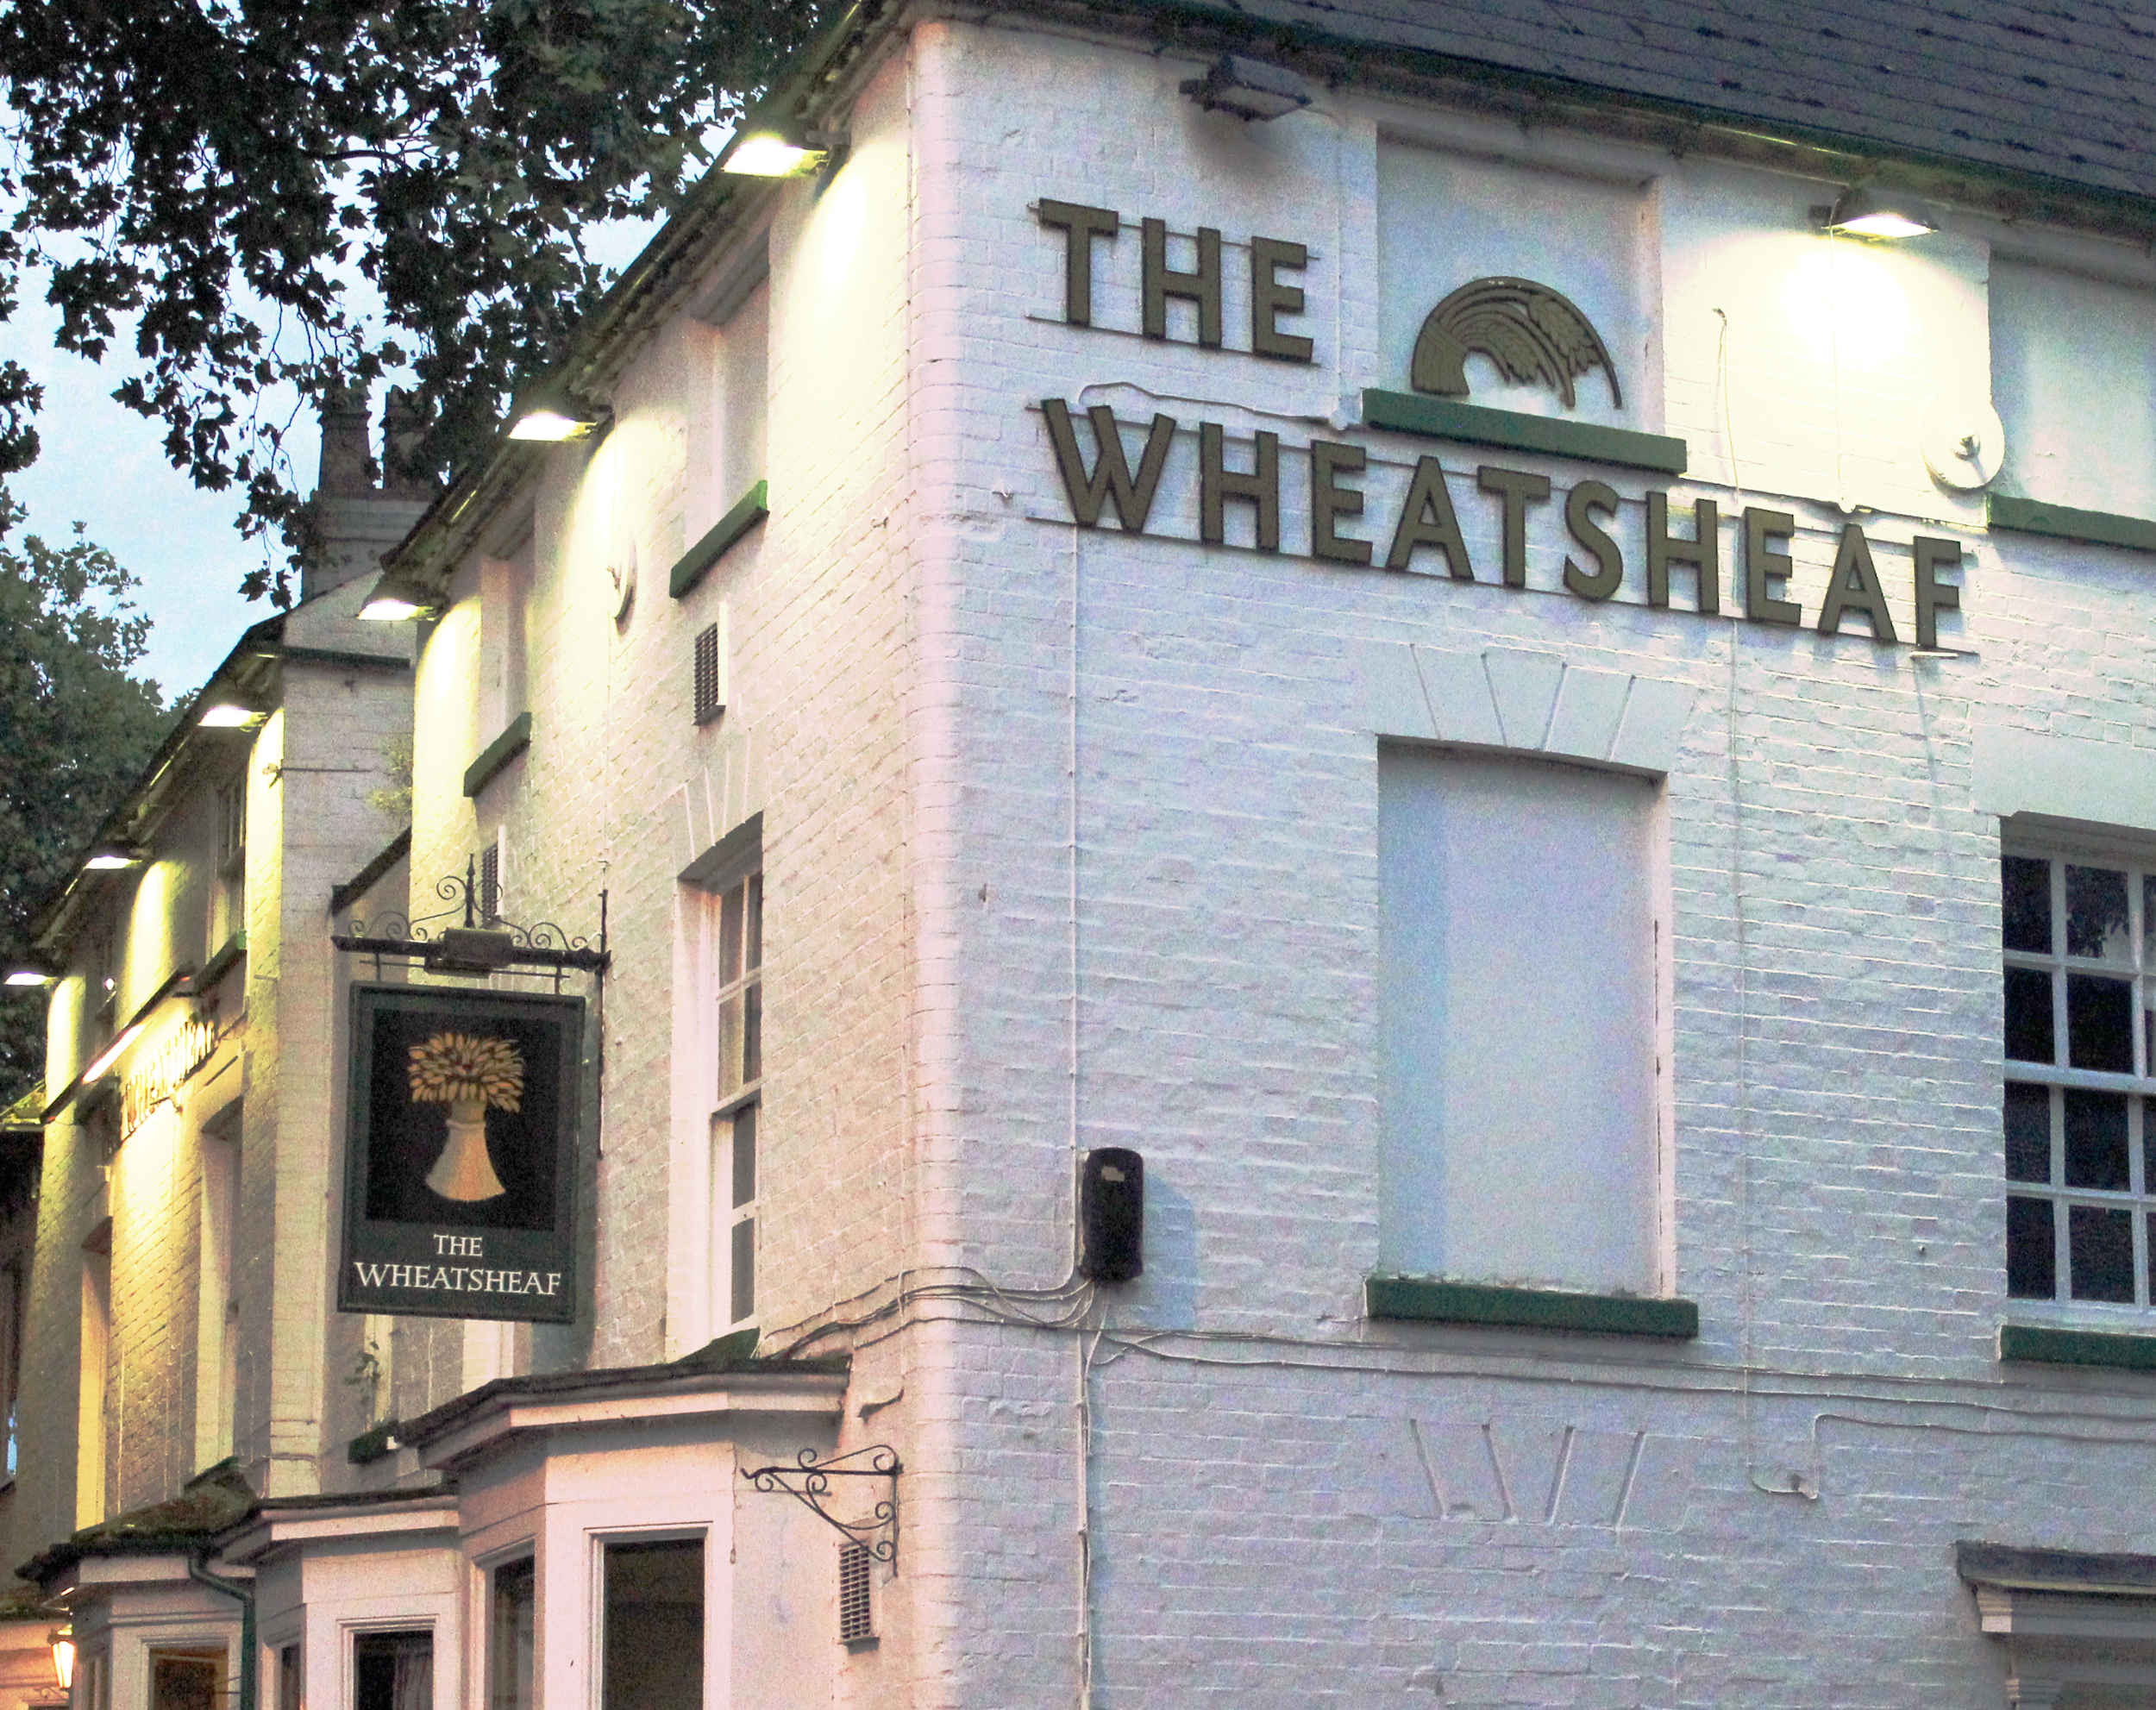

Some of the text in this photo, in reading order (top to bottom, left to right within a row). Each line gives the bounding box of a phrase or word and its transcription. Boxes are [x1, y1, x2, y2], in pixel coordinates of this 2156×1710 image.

[1038, 197, 1313, 362] THE
[1041, 398, 1962, 648] WHEATSHEAF
[354, 1262, 561, 1294] WHEATSHEAF
[434, 1234, 483, 1256] THE
